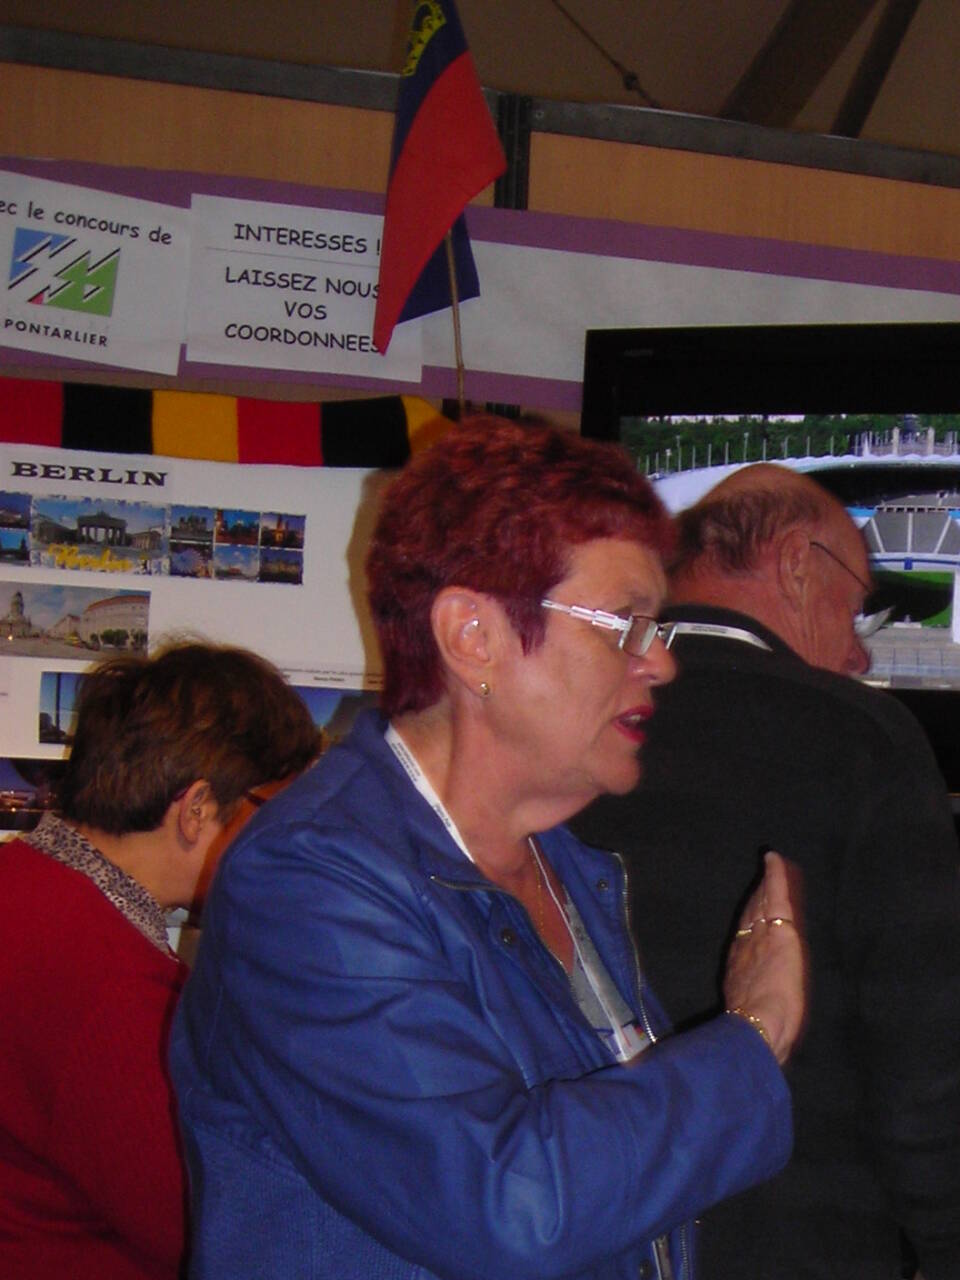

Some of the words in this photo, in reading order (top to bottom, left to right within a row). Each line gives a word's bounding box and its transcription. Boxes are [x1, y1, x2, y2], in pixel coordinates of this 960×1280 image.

[28, 201, 45, 220] le
[54, 210, 140, 239] concours
[148, 227, 172, 245] de
[233, 223, 367, 254] INTERESSES
[225, 266, 317, 292] LAISSEZ
[284, 300, 327, 320] VOS
[4, 318, 108, 347] PONTARLIER
[11, 461, 168, 487] BERLIN
